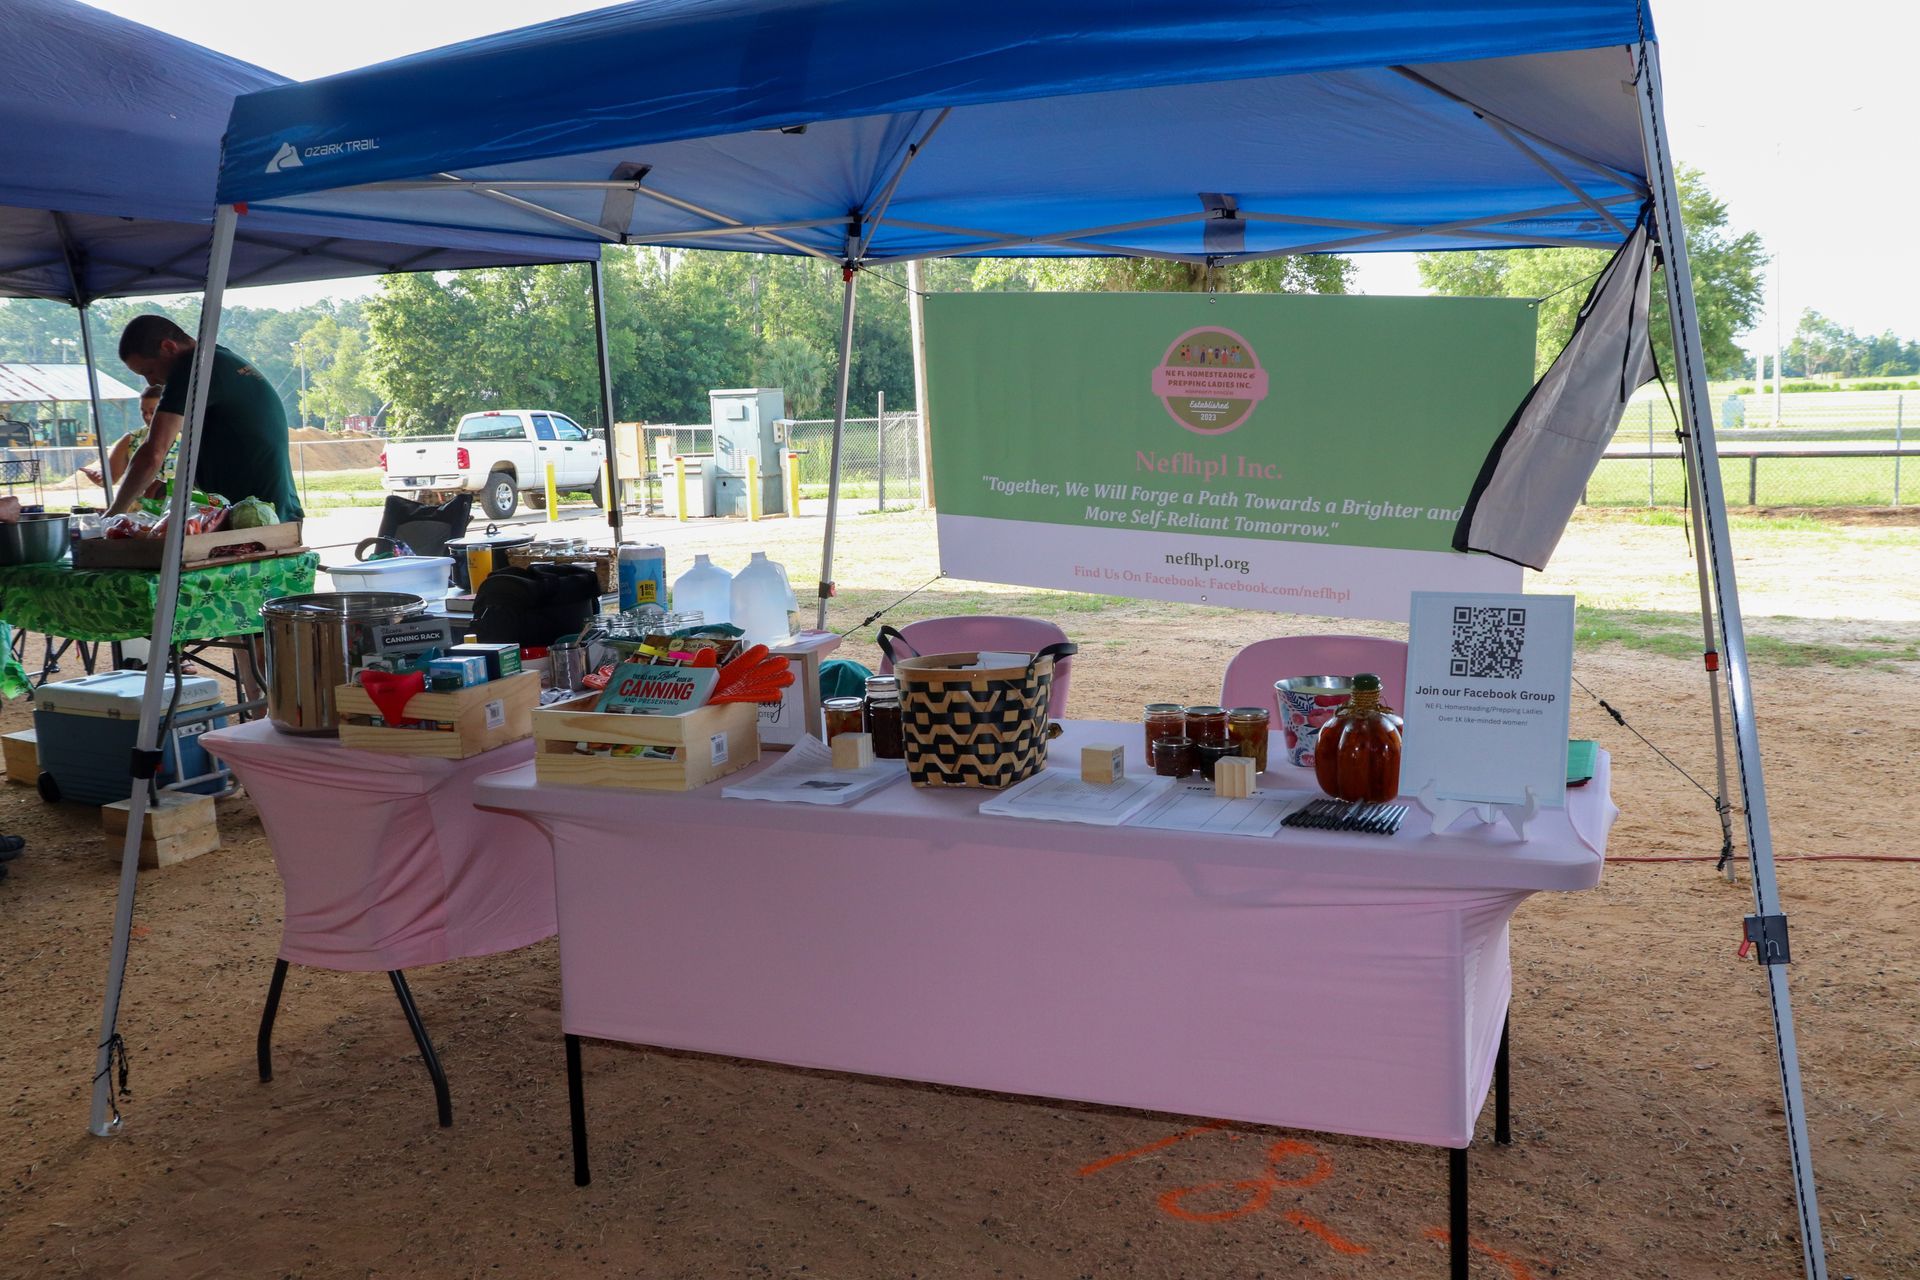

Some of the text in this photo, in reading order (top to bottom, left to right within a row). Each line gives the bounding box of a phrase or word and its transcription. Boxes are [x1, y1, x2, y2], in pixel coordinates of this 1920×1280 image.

[304, 139, 380, 158] OZARK TRAIL
[1167, 380, 1206, 388] PREPPING
[1187, 371, 1247, 379] HOMESTEADING
[1189, 400, 1229, 409] Established
[1200, 413, 1217, 421] 2023
[1136, 451, 1282, 483] Neflhpl Inc.
[982, 475, 1464, 522] "Together, We Will Forge a Path Towards a Brighter and
[1085, 505, 1340, 538] More Self-Reliant Tomorrow."
[1165, 552, 1250, 574] neflhpl.org
[1074, 565, 1351, 604] Find Us On Facebook: Facebook.com/neflhpl
[385, 632, 440, 644] CANNING RACK
[619, 679, 695, 700] CANNING
[1416, 685, 1555, 704] Join our Facebook Group
[638, 698, 679, 706] PRESERVING
[1463, 716, 1502, 726] like-minded
